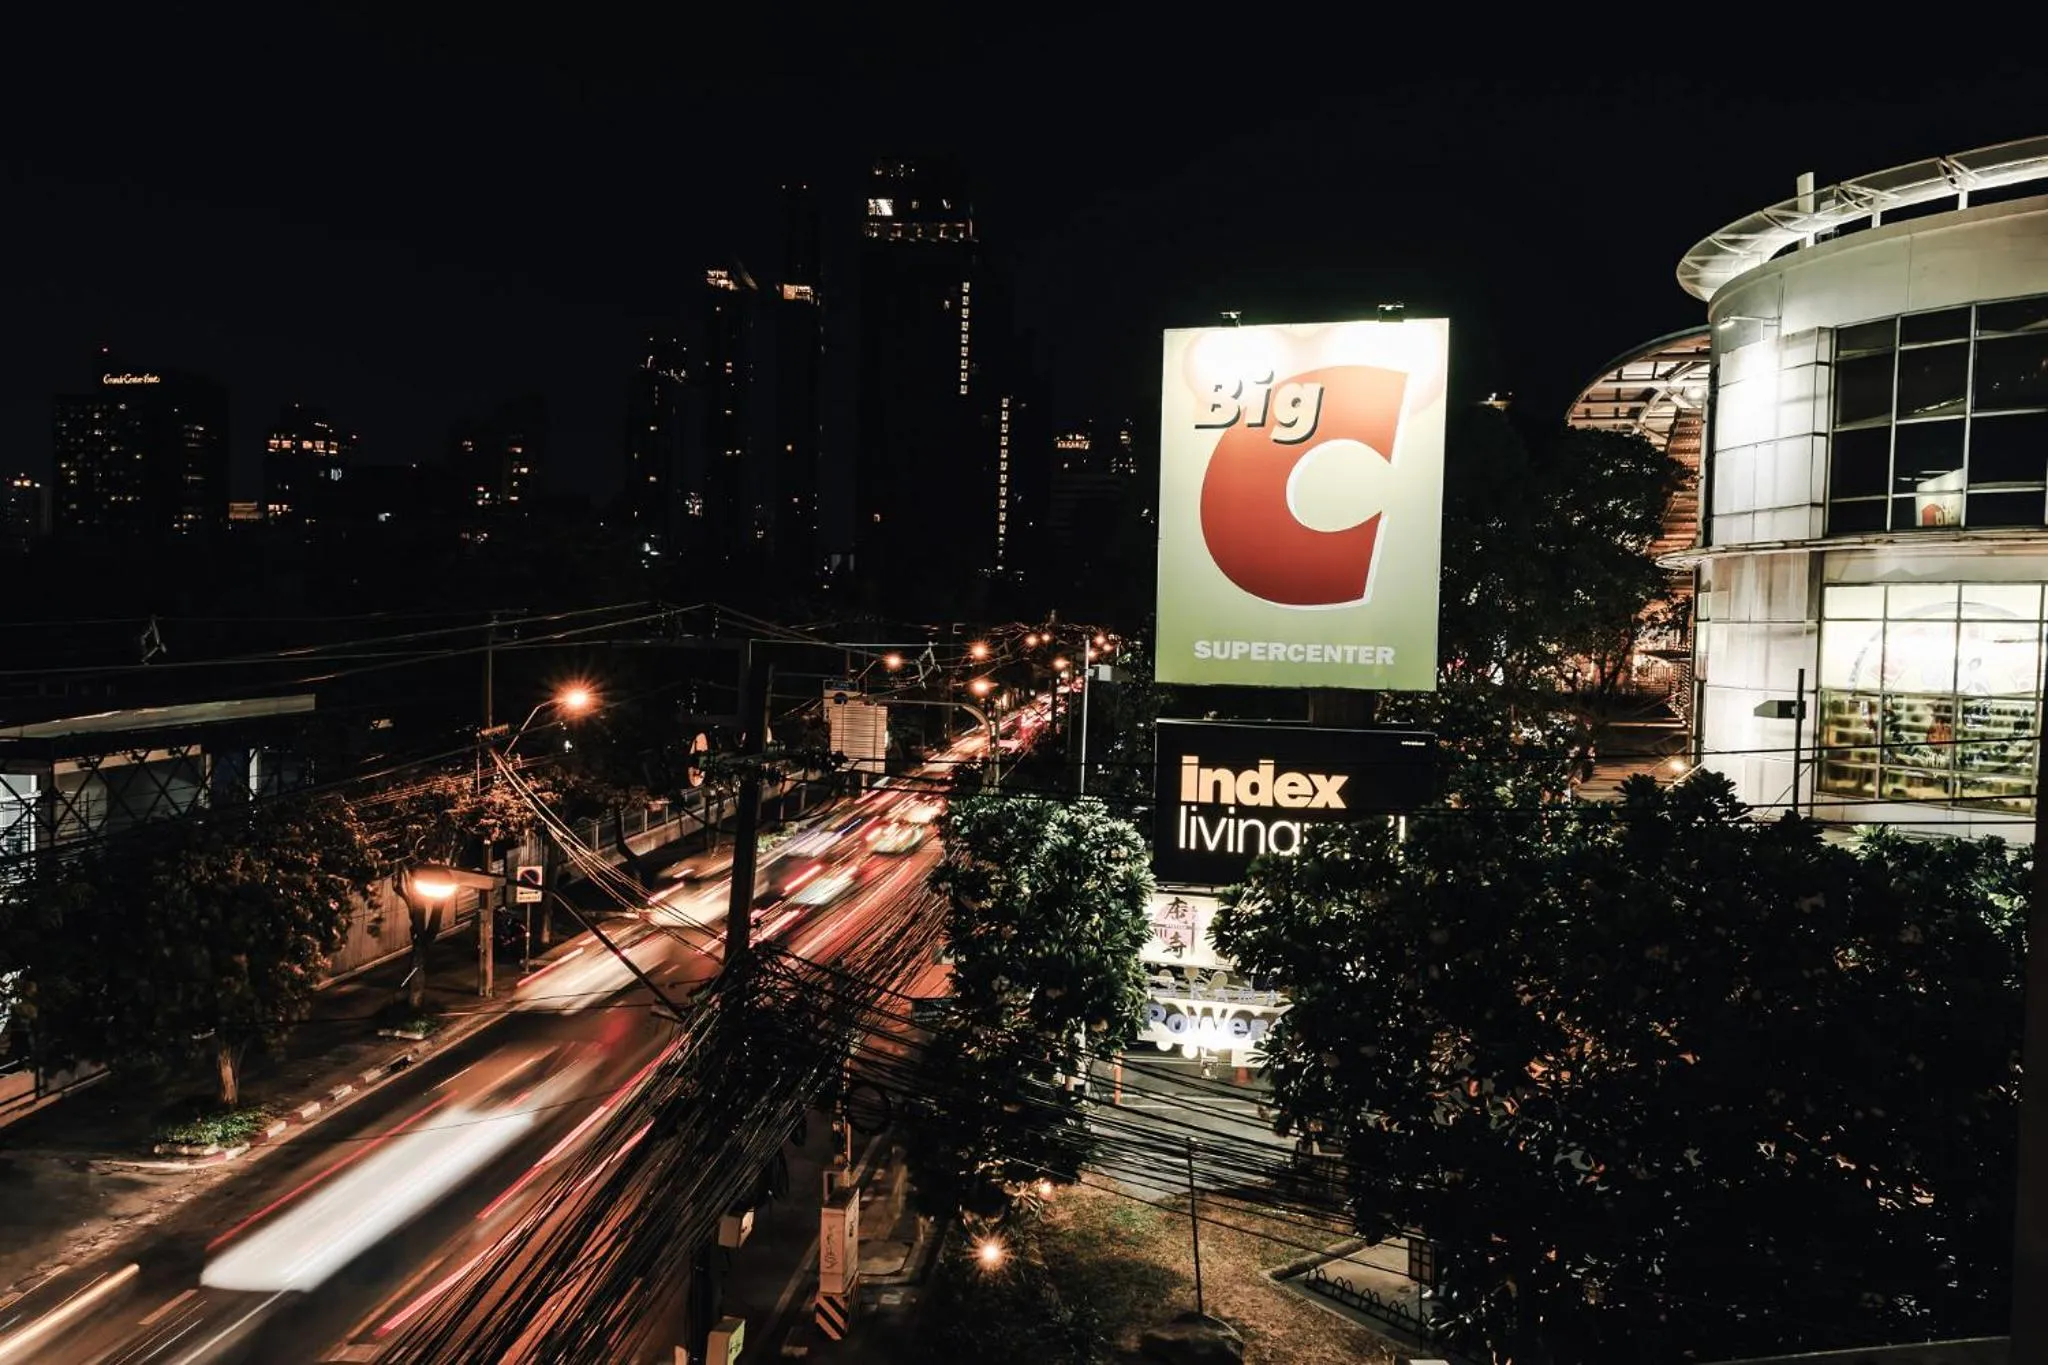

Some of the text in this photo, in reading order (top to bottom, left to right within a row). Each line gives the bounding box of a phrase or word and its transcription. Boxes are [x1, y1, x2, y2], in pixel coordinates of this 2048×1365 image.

[1195, 364, 1412, 610] Big C
[1194, 640, 1395, 666] SUPERCENTER
[1180, 755, 1350, 810] index
